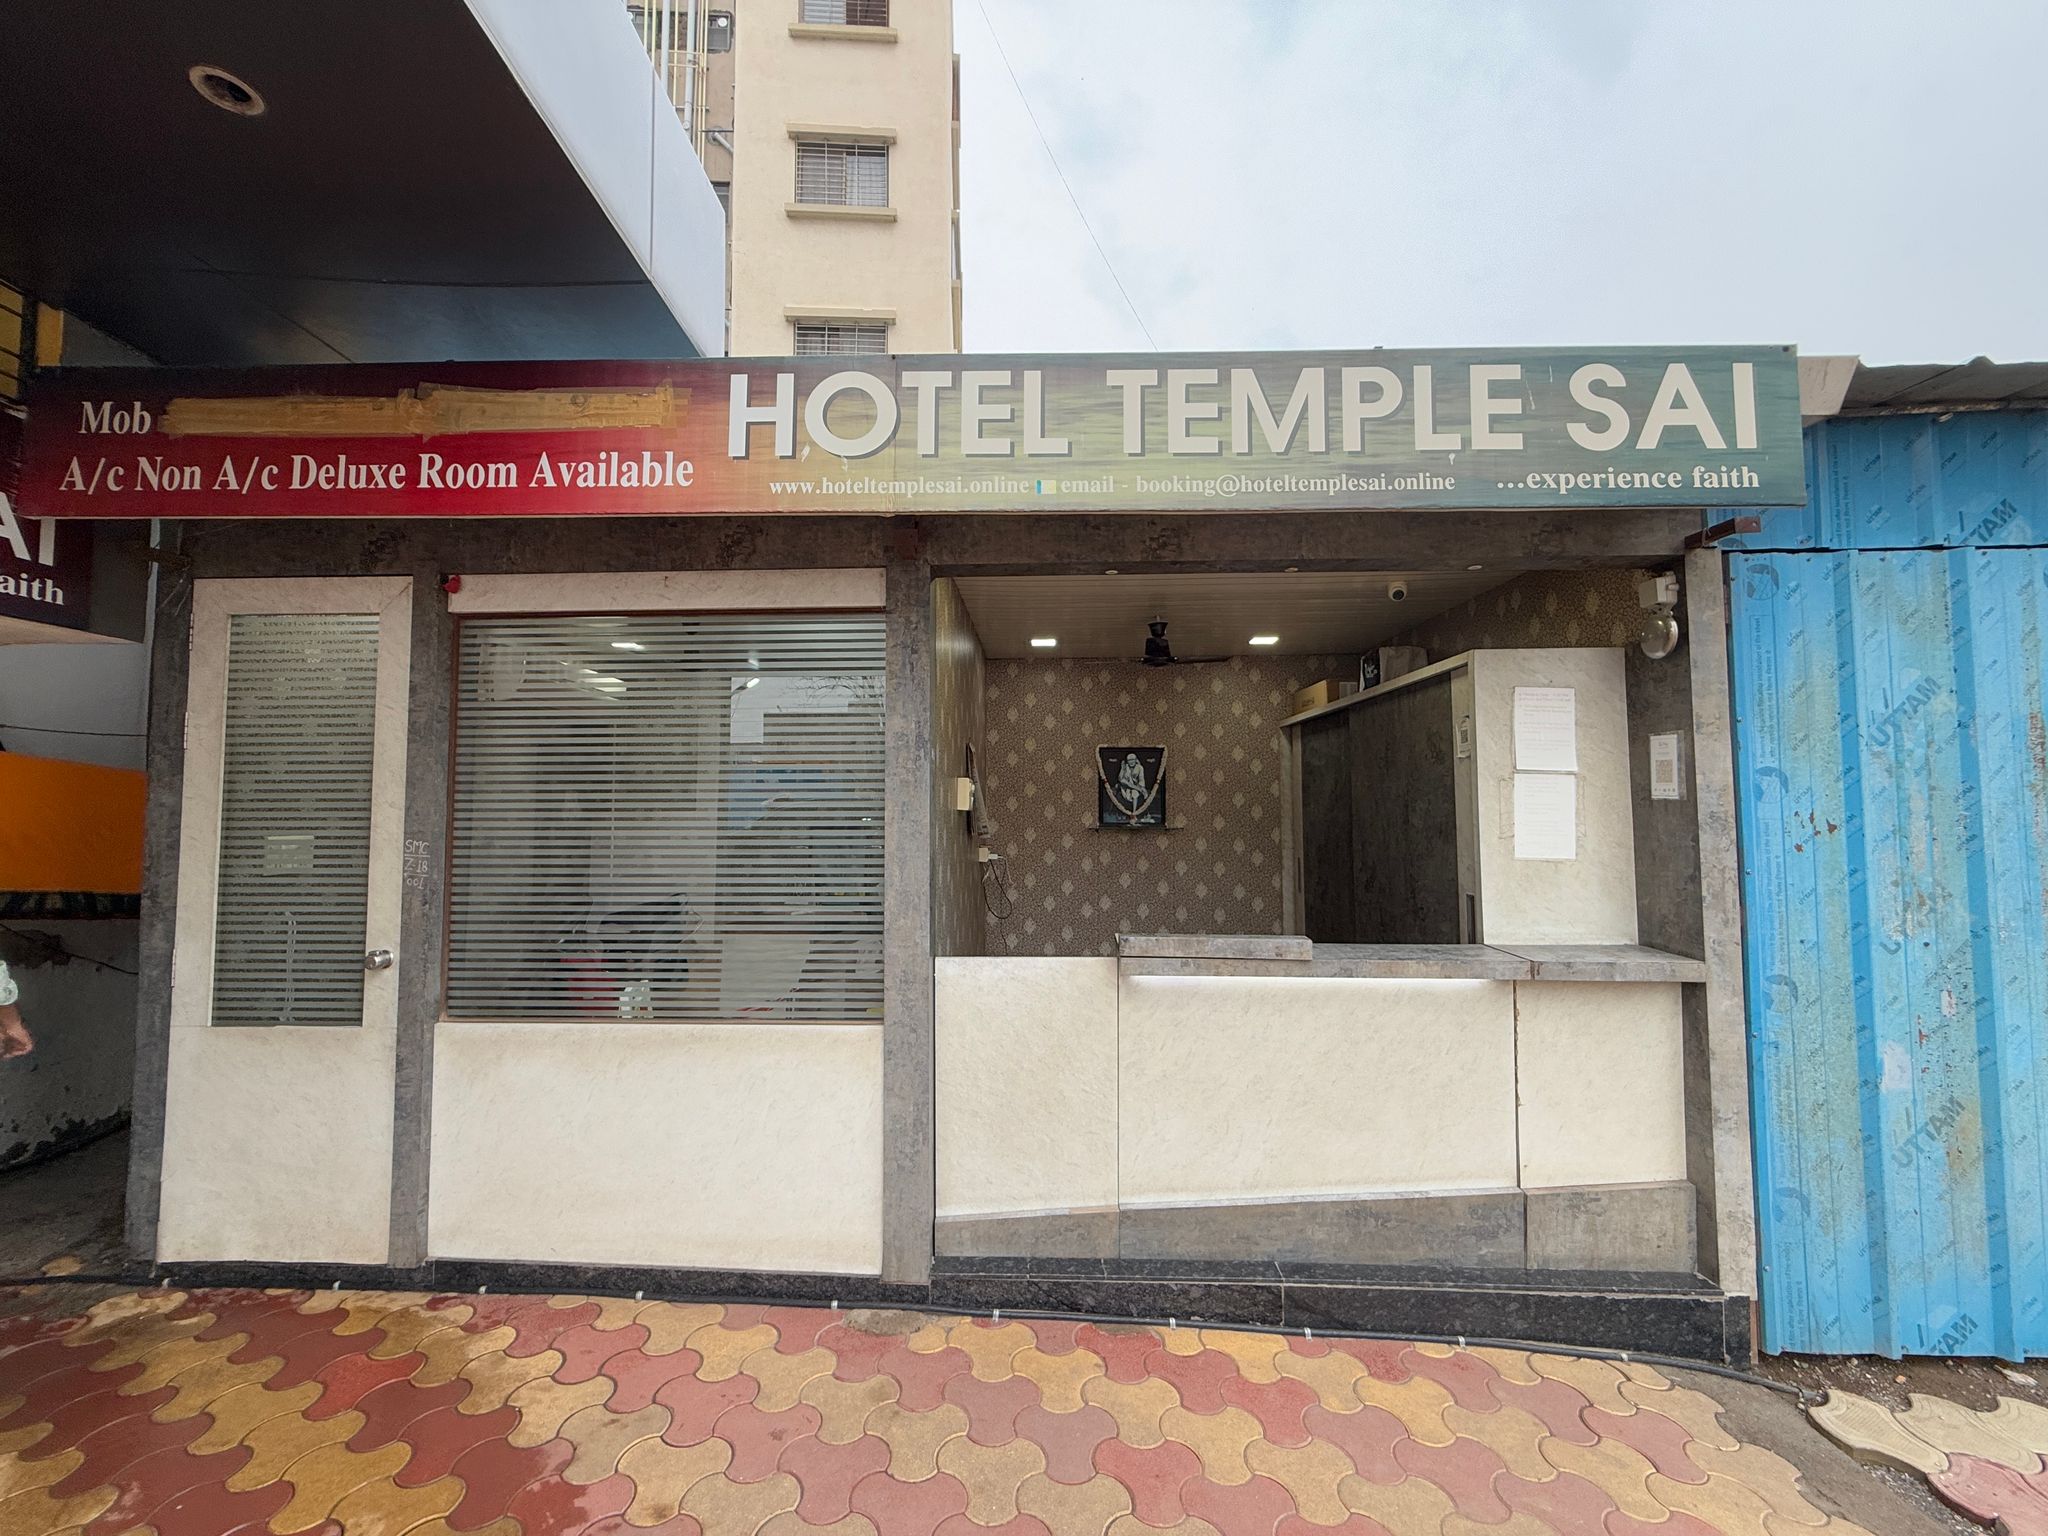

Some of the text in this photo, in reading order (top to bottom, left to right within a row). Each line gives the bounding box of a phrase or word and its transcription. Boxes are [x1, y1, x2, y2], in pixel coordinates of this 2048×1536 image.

[79, 401, 151, 434] Mob
[728, 362, 1758, 460] HOTEL TEMPLE SAI
[59, 450, 694, 495] A/c Non A/c Deluxe Room Available
[768, 474, 1031, 498] www.hoteltemplesai.online
[1060, 474, 1115, 494] email
[1135, 471, 1457, 498] booking@hoteltemplesai.online
[1692, 464, 1761, 489] faith
[404, 839, 430, 855] SMC
